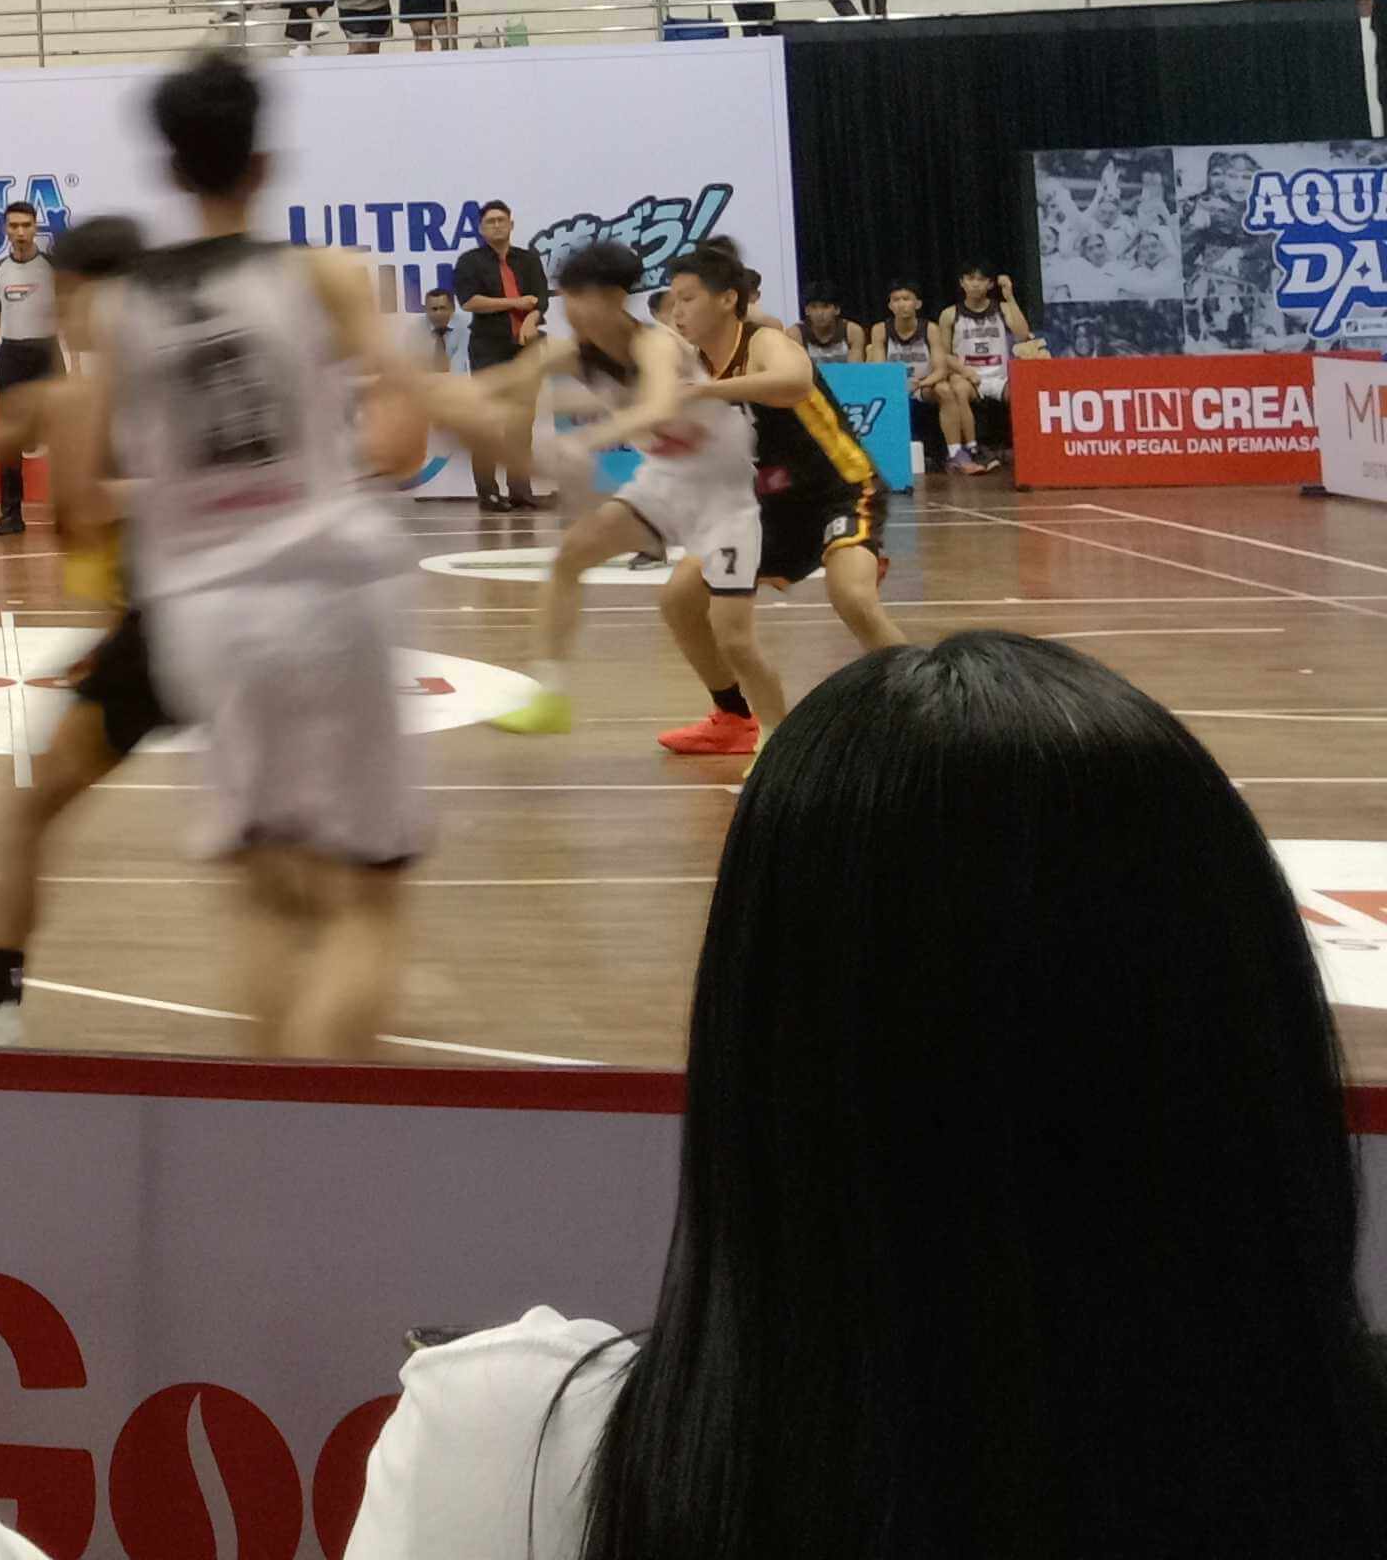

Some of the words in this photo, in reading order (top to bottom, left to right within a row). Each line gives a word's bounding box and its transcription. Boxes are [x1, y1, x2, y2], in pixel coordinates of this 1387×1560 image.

[288, 199, 487, 253] ULTRA
[1246, 169, 1387, 234] AQU
[1277, 239, 1387, 333] DA
[1190, 384, 1319, 431] CREA
[1064, 440, 1122, 457] UNTUK
[1126, 438, 1183, 455] PEGAL
[1187, 438, 1223, 454] DAN
[719, 546, 738, 576] 7
